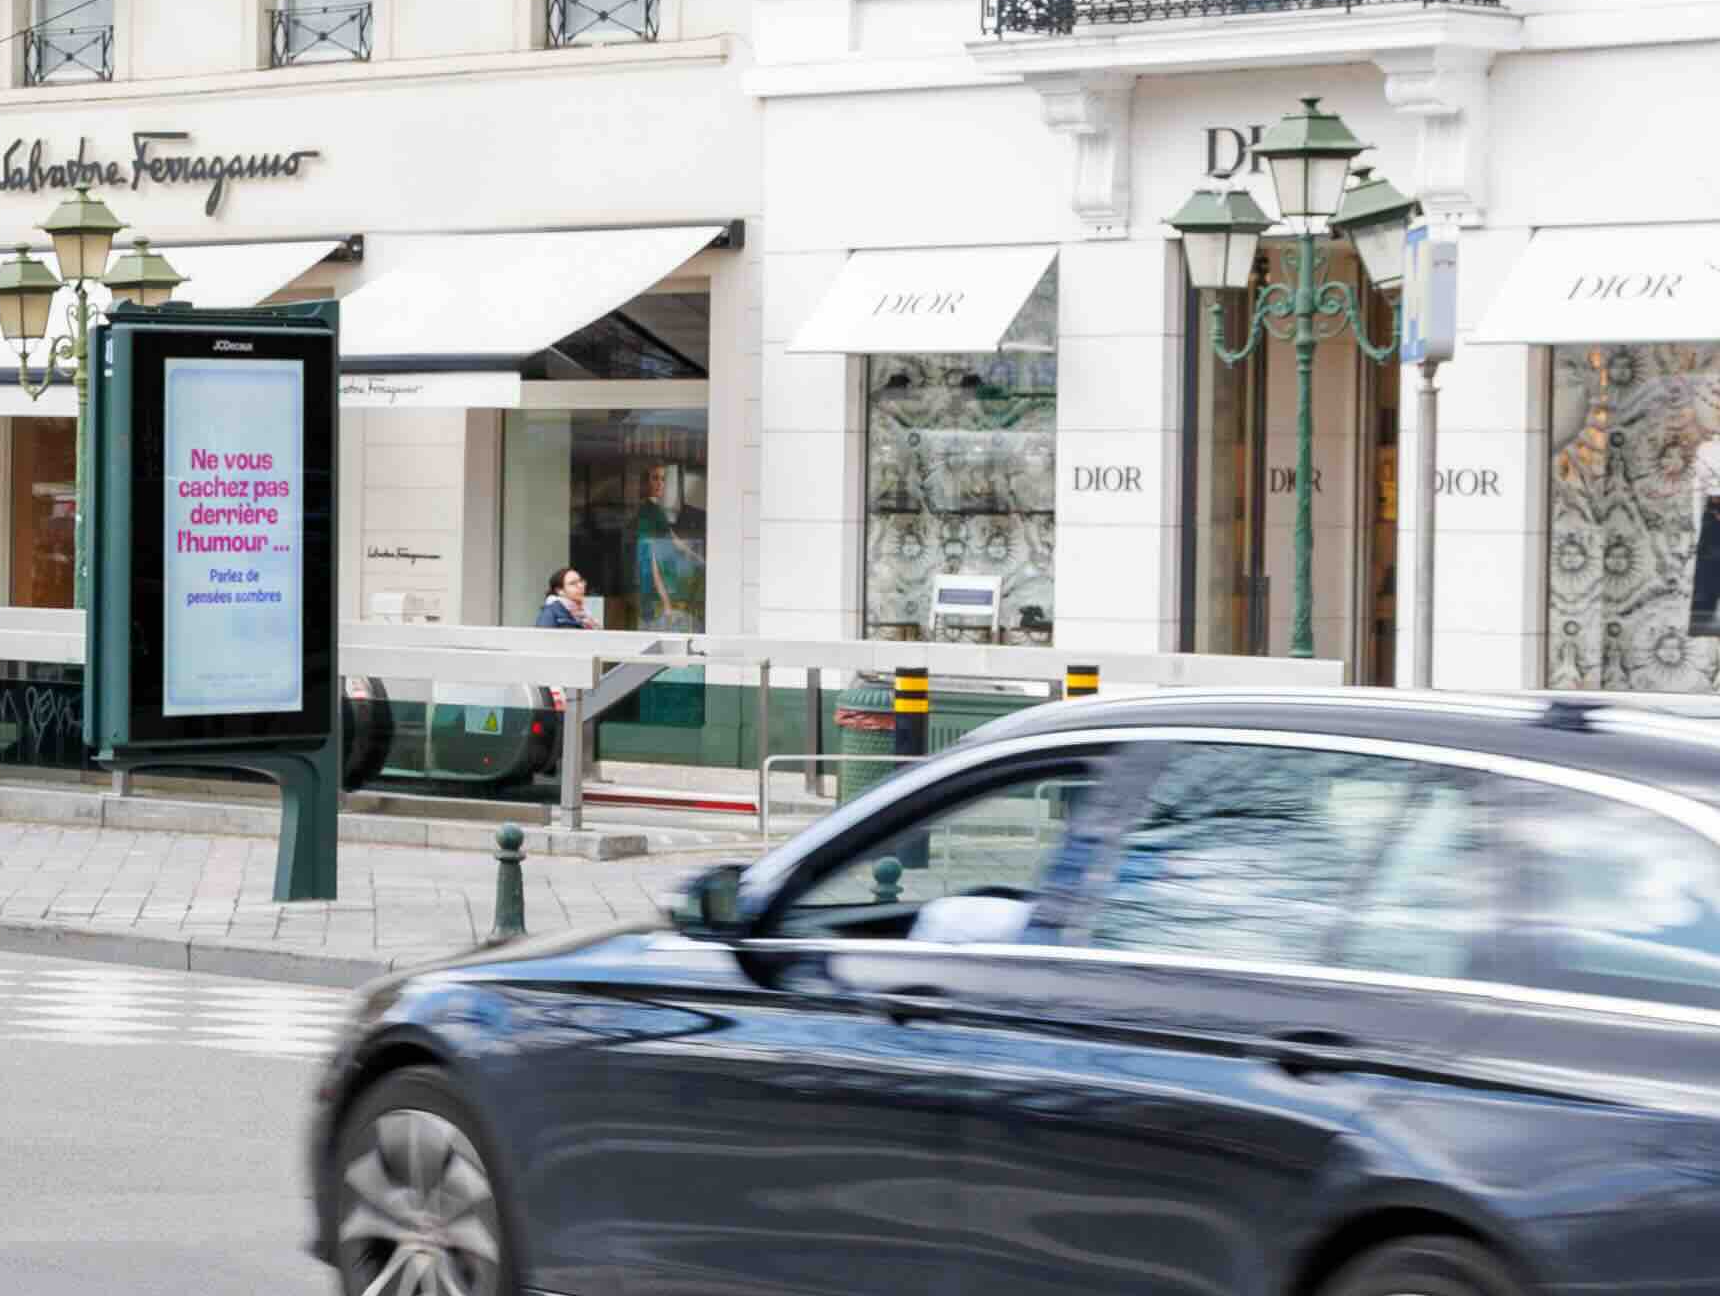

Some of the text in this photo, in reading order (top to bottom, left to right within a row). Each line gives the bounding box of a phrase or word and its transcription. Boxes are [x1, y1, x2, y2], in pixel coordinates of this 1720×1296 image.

[133, 132, 320, 218] Ferragamo
[191, 448, 273, 470] Ne vous
[178, 476, 290, 503] cachez pas
[1073, 465, 1144, 493] DIOR
[1269, 467, 1323, 494] DIR
[190, 502, 279, 525] derrière
[177, 528, 269, 553] l'humour
[210, 568, 260, 583] Parlez de
